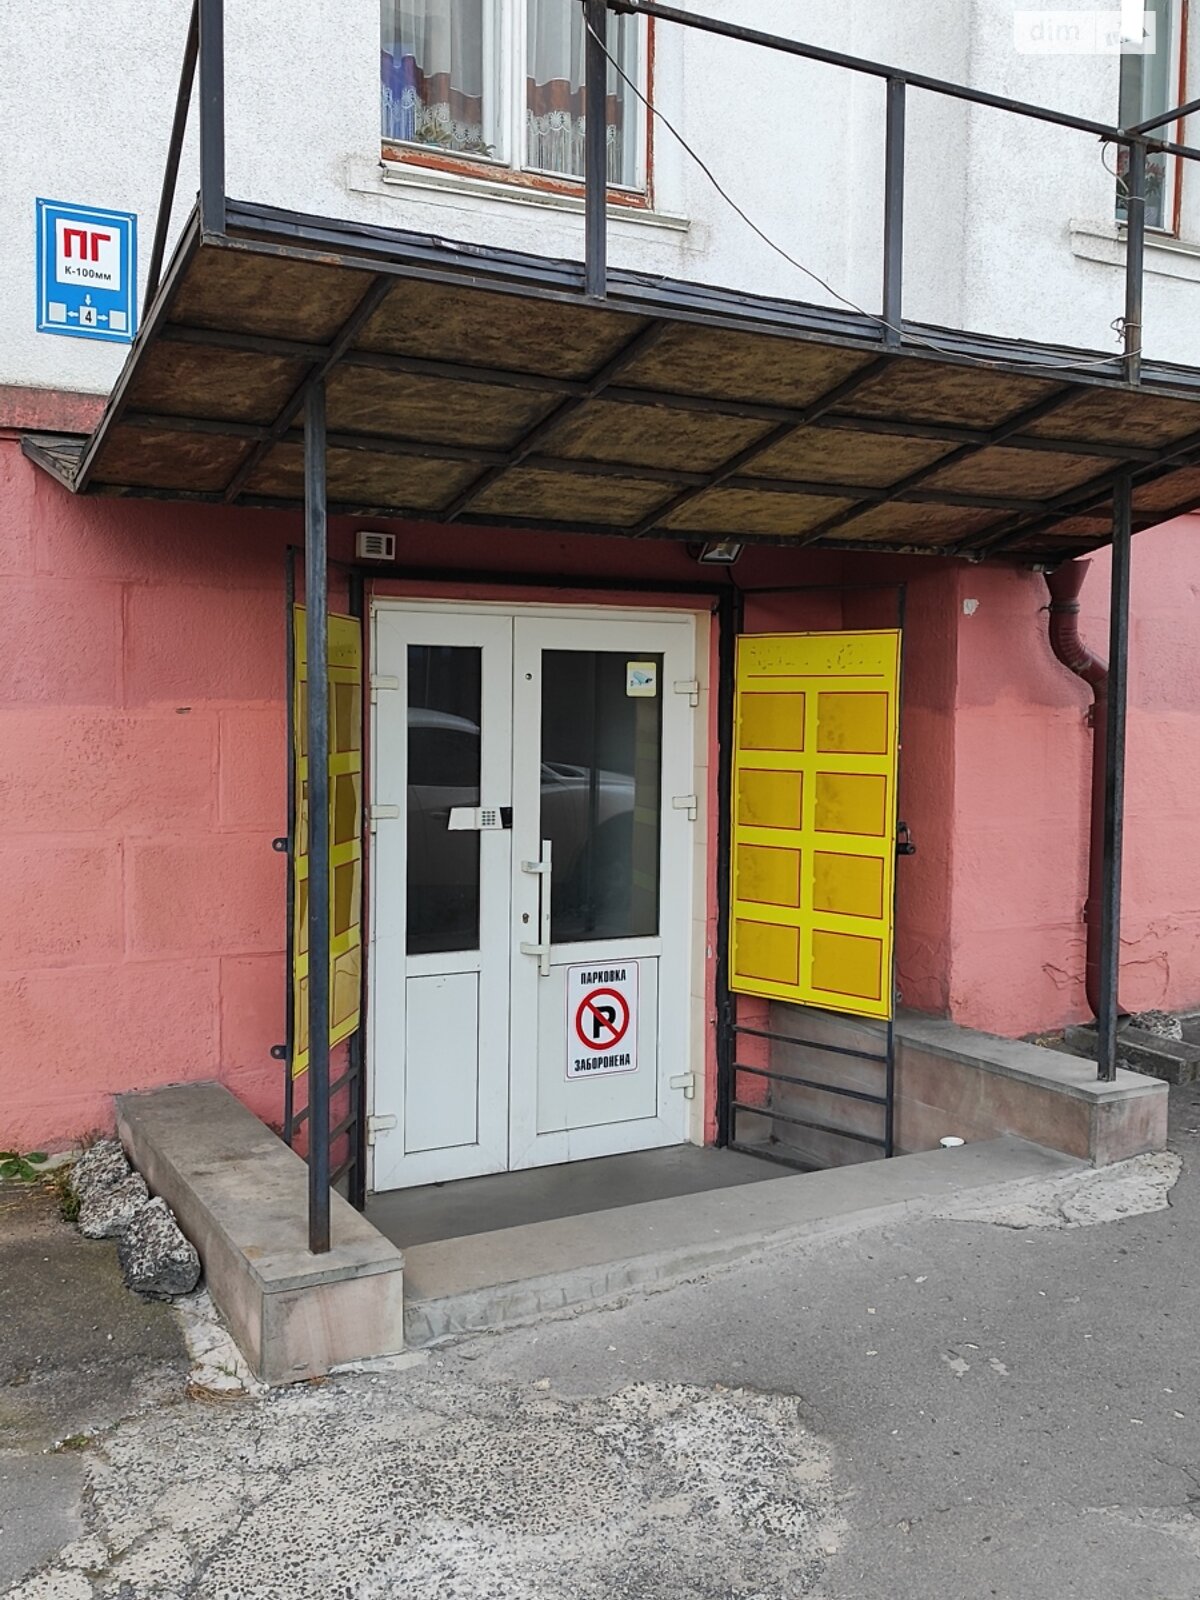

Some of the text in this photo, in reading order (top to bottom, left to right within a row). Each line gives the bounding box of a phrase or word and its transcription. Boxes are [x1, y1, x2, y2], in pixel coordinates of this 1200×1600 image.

[63, 227, 111, 262] ПГ
[64, 265, 112, 281] К-100мм
[84, 310, 93, 323] 4
[580, 969, 627, 985] ПАРКОВКА
[574, 1053, 631, 1072] ЗАБОРОНЕНА
